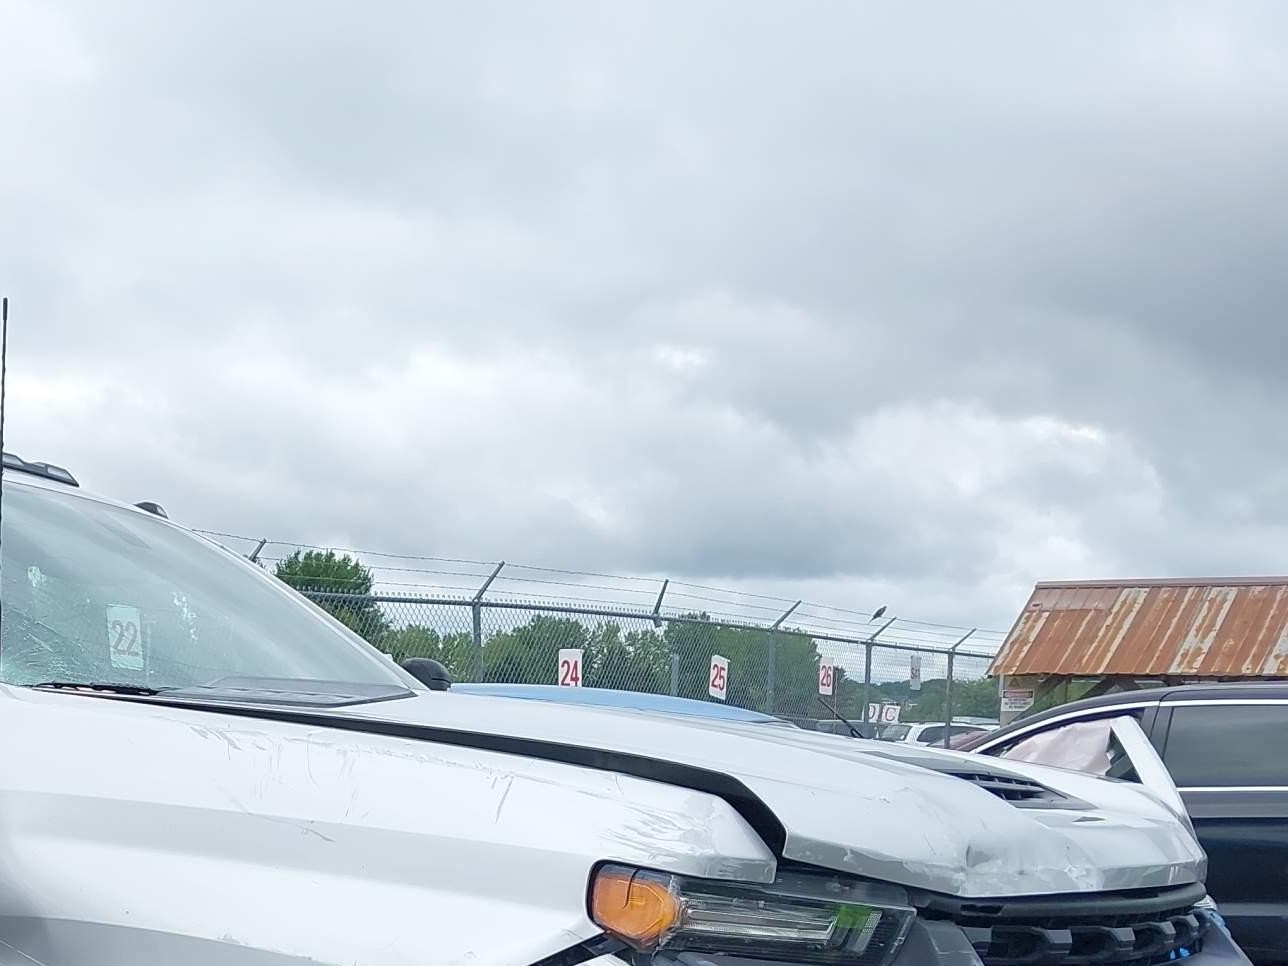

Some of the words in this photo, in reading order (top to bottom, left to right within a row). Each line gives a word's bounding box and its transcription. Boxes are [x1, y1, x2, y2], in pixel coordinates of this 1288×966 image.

[112, 620, 140, 657] 22
[561, 660, 580, 687] 24
[712, 664, 726, 691] 25
[820, 665, 832, 688] 26
[885, 706, 896, 721] C
